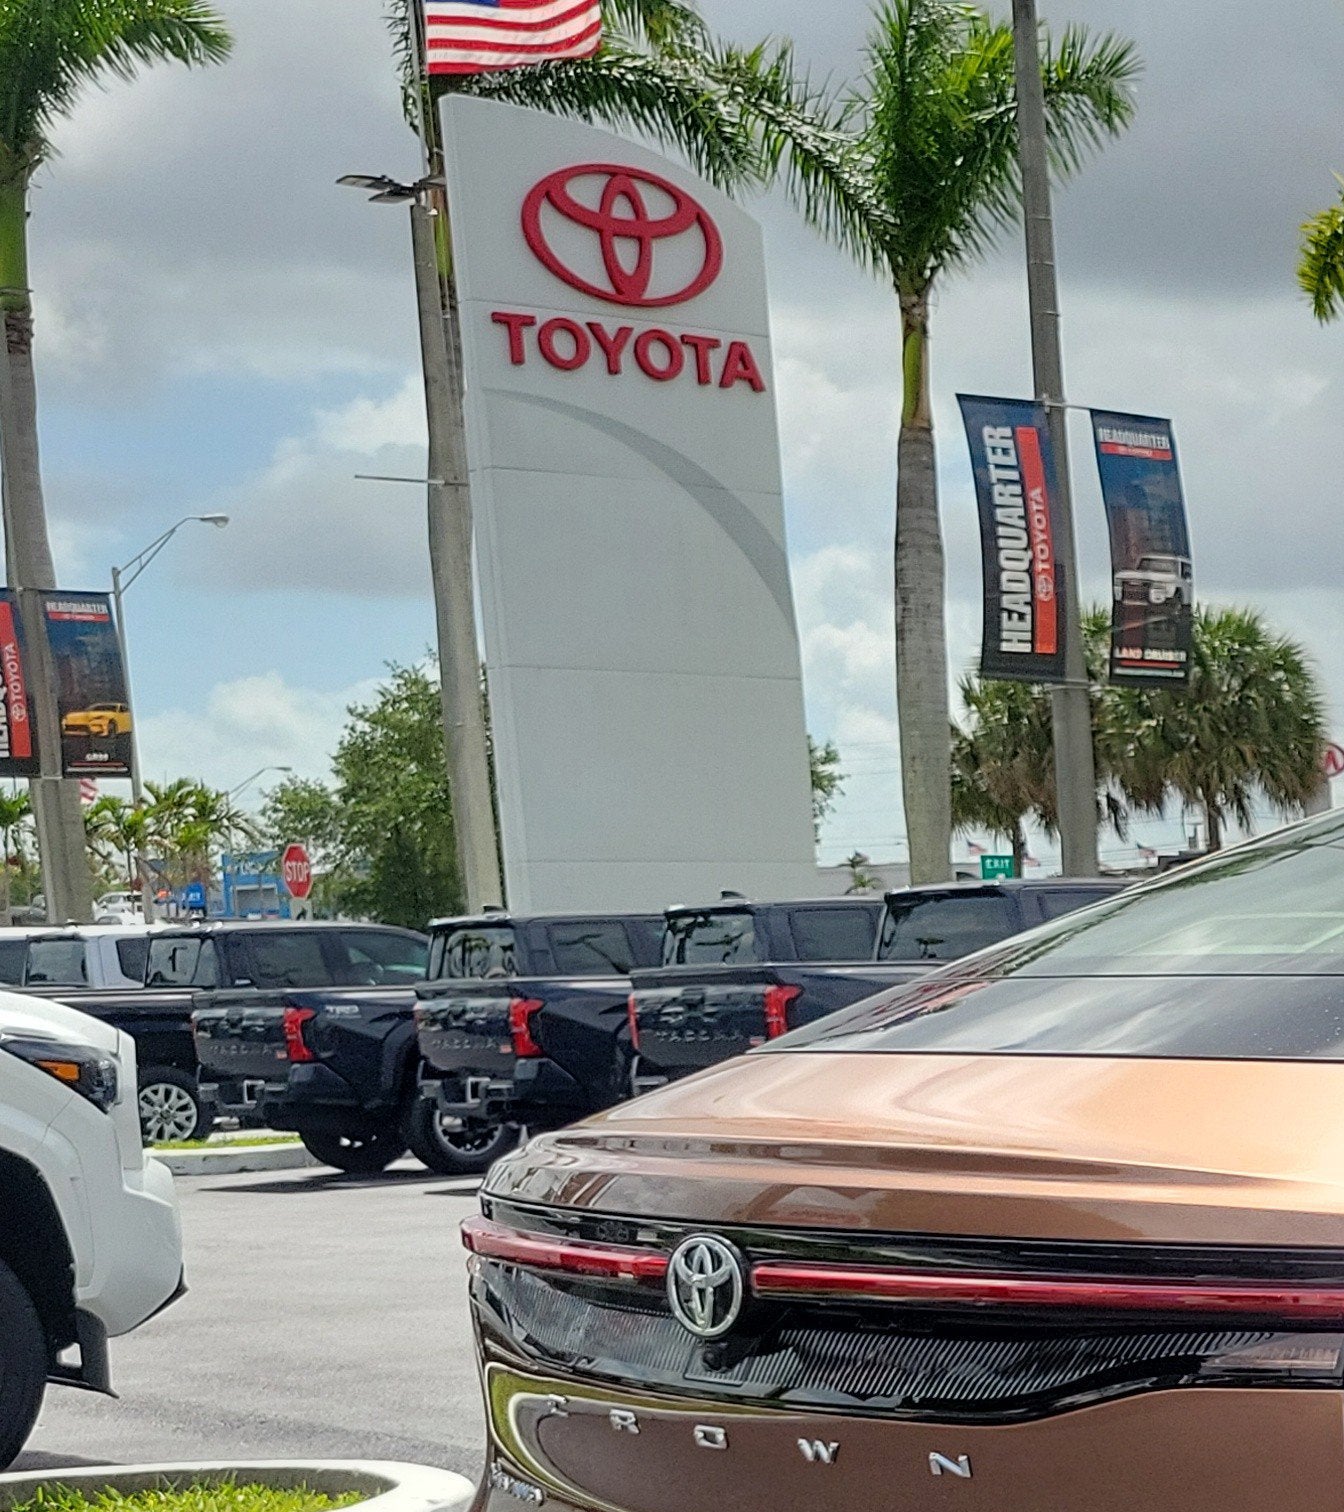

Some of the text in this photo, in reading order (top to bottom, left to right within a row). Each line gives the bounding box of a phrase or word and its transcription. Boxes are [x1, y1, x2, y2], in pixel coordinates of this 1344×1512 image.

[491, 312, 767, 393] TOYOTA
[982, 425, 1033, 654] HEADQUARTER
[1030, 486, 1051, 571] TOYOTA
[3, 642, 22, 702] TOYOTA
[285, 861, 310, 882] STOP
[984, 857, 1011, 869] EXIT
[547, 1394, 973, 1479] CROWN
